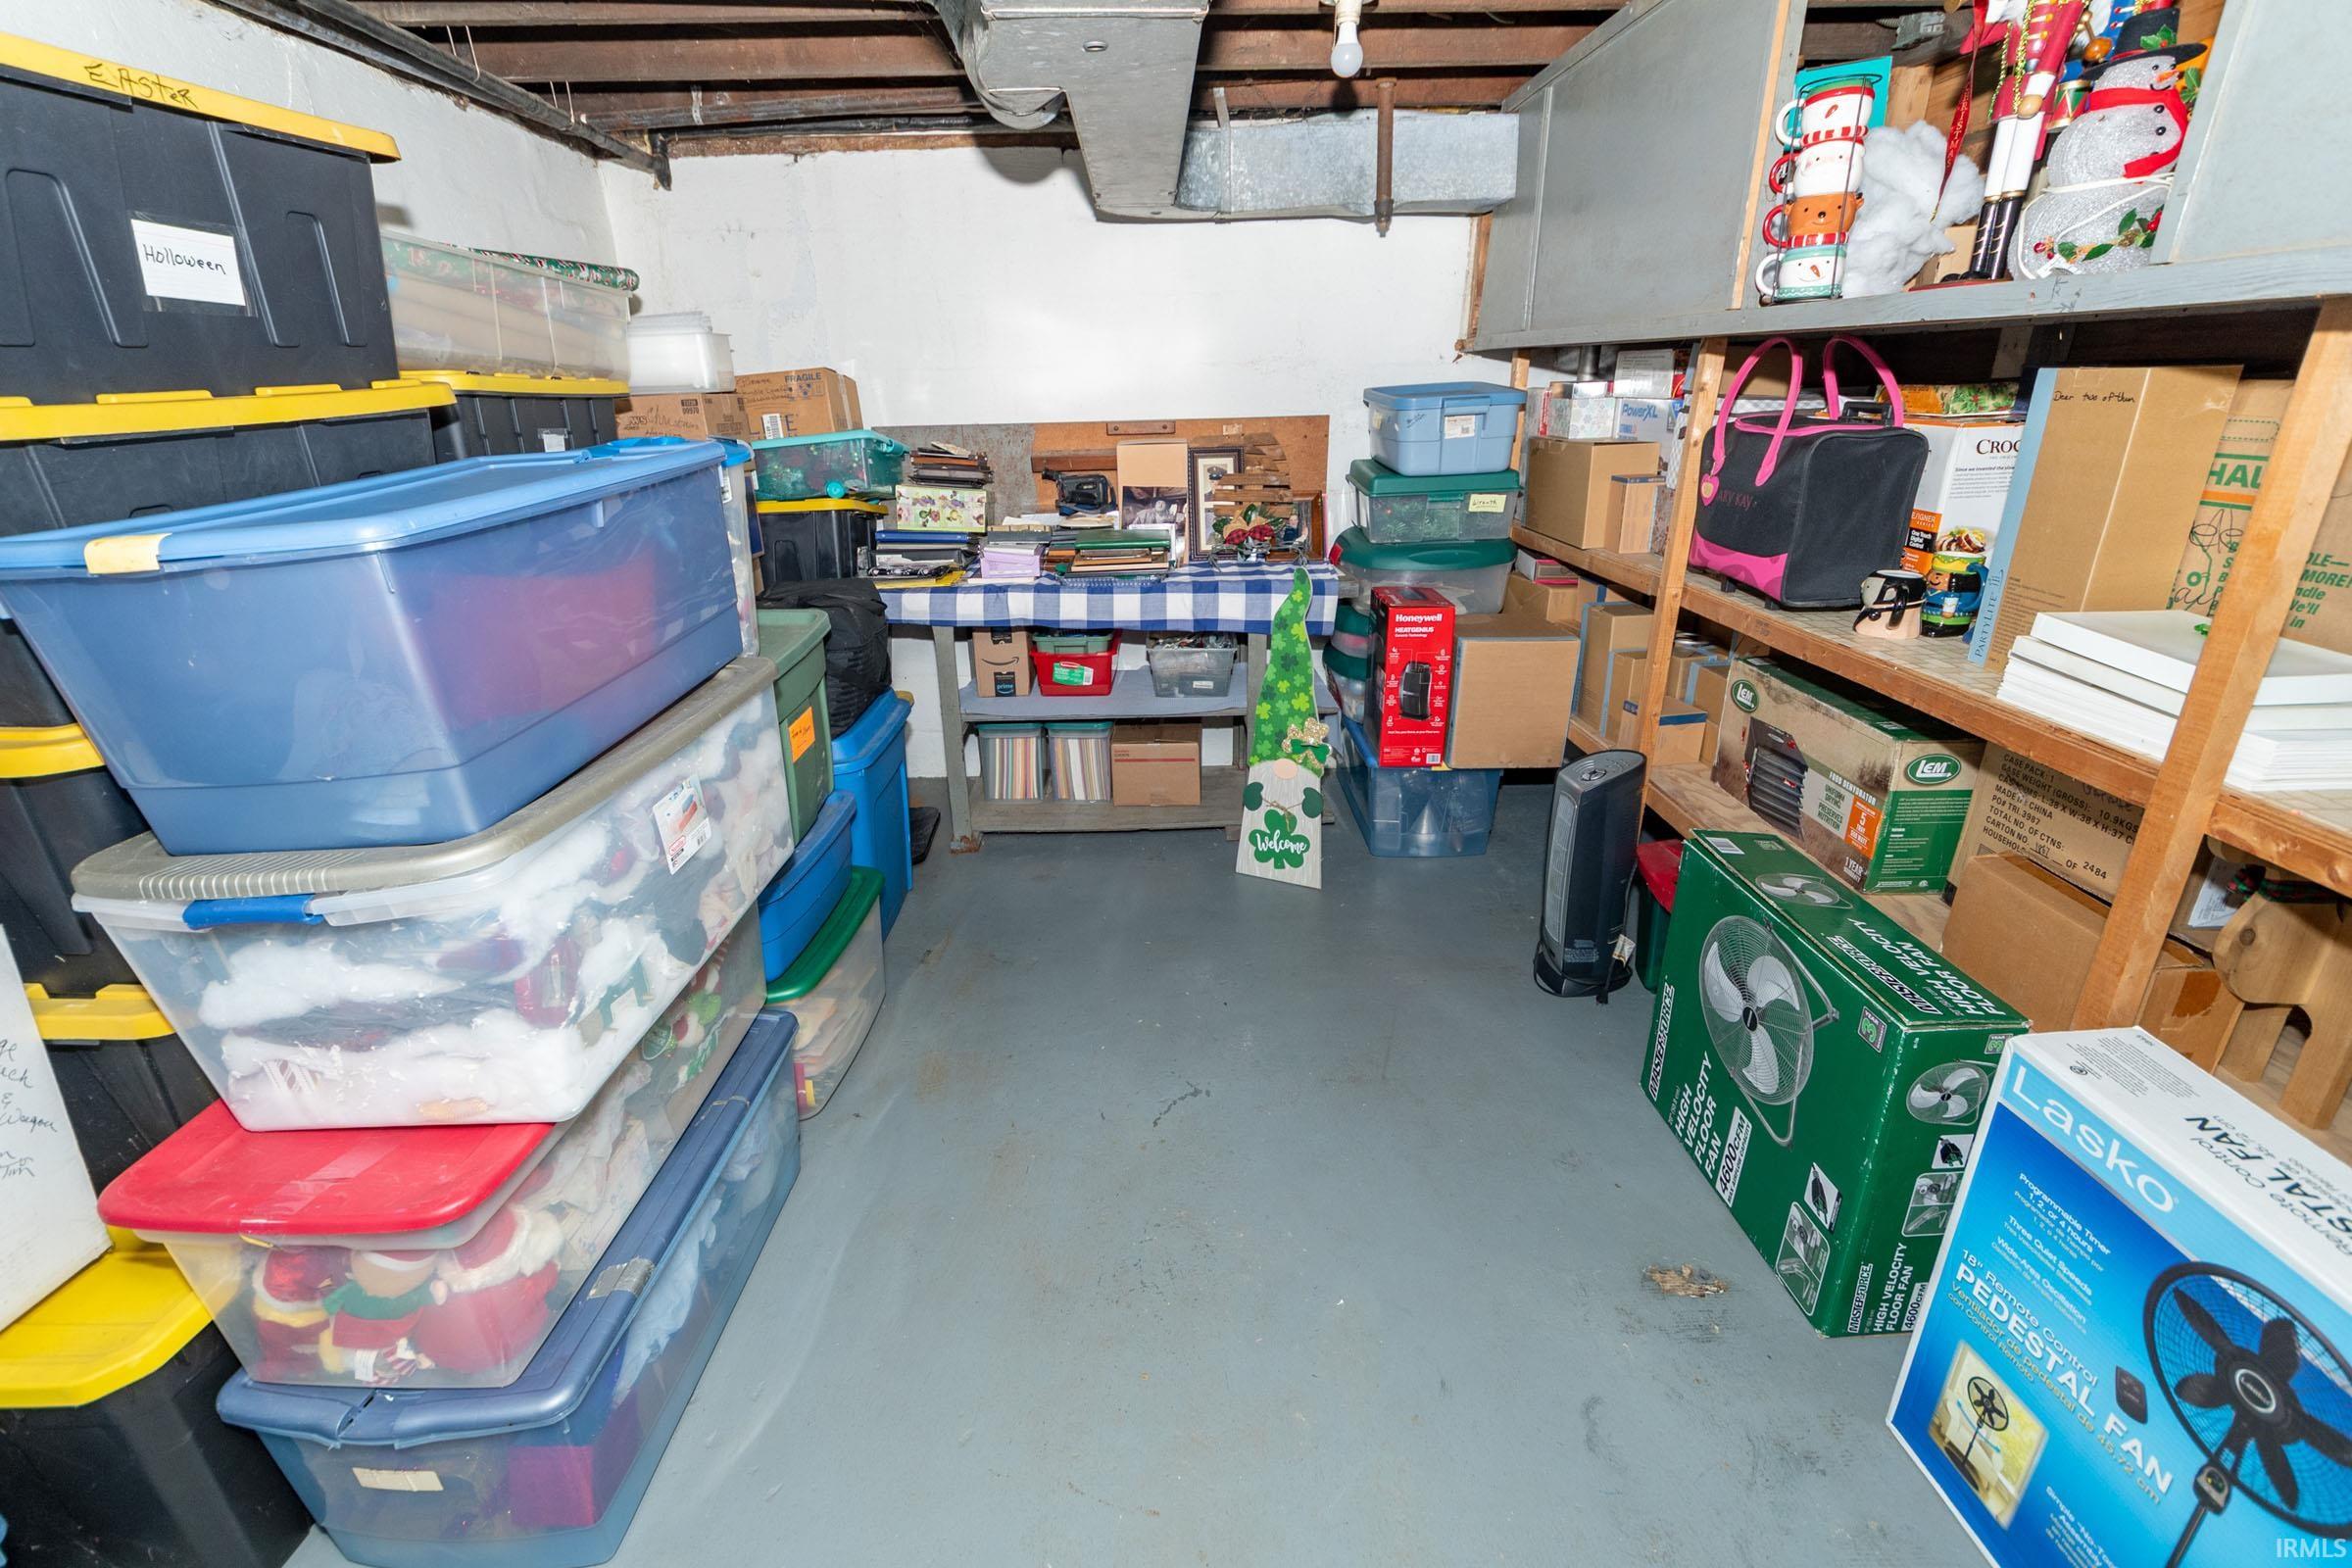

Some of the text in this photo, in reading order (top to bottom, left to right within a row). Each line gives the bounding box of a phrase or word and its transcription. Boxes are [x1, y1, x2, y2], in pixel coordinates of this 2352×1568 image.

[784, 372, 821, 383] FRAGILE
[1623, 403, 1658, 421] PowerXL
[1396, 613, 1443, 623] Honeywell
[1975, 594, 1998, 658] PARTYLITE
[2289, 616, 2305, 629] in
[1737, 683, 1755, 709] LEM
[1916, 760, 1952, 778] LEM
[2004, 754, 2024, 769] CASE
[2022, 772, 2053, 792] WEIGHT
[1859, 812, 1867, 825] 5
[1994, 784, 2054, 820] MADE CHINA
[1255, 829, 1307, 855] Welcome
[1985, 815, 2016, 838] CARTON
[2016, 833, 2031, 846] NO.
[2066, 859, 2080, 870] OF
[2082, 861, 2108, 879] 2484
[1989, 805, 2013, 824] TOTAL
[2012, 817, 2027, 831] NO.
[2028, 826, 2039, 837] OF
[2039, 833, 2065, 852] CTNS:
[2126, 836, 2135, 846] C
[1847, 917, 1931, 976] VELOCITY
[1895, 941, 1940, 968] FAN
[1926, 979, 1984, 1015] HIGH
[1935, 969, 2006, 1015] FLOOR
[1861, 1017, 1878, 1044] 3
[1675, 1083, 1693, 1138] HIGH
[1685, 1051, 1714, 1149] VELOCITY
[1694, 1095, 1717, 1165] FLOOR
[2013, 1065, 2175, 1213] Lasko
[2184, 1115, 2264, 1160] FAN
[1704, 1132, 1723, 1179] FAN
[2189, 1137, 2266, 1190] Control
[2019, 1173, 2111, 1255] Programmable Timer
[2047, 1209, 2059, 1221] or
[2059, 1219, 2066, 1228] 4
[2067, 1225, 2094, 1253] hours
[2009, 1215, 2093, 1297] Three Quiet Speeds
[1873, 1242, 1907, 1333] HIGH VELOCITY
[1886, 1265, 1914, 1332] FLOOR FAN
[1997, 1235, 2087, 1325] Wide-Area Oscillation
[1947, 1293, 2034, 1383] con Control Remoto
[1963, 1249, 2099, 1388] 18" Remote Control
[1952, 1281, 2005, 1338] Ventilador
[2006, 1338, 2023, 1356] de
[2076, 1413, 2094, 1433] de
[2136, 1476, 2161, 1505] cm
[1956, 1262, 2174, 1495] PEDESTAL FAN
[2045, 1486, 2076, 1524] Simple
[2059, 1514, 2103, 1567] Assembly
